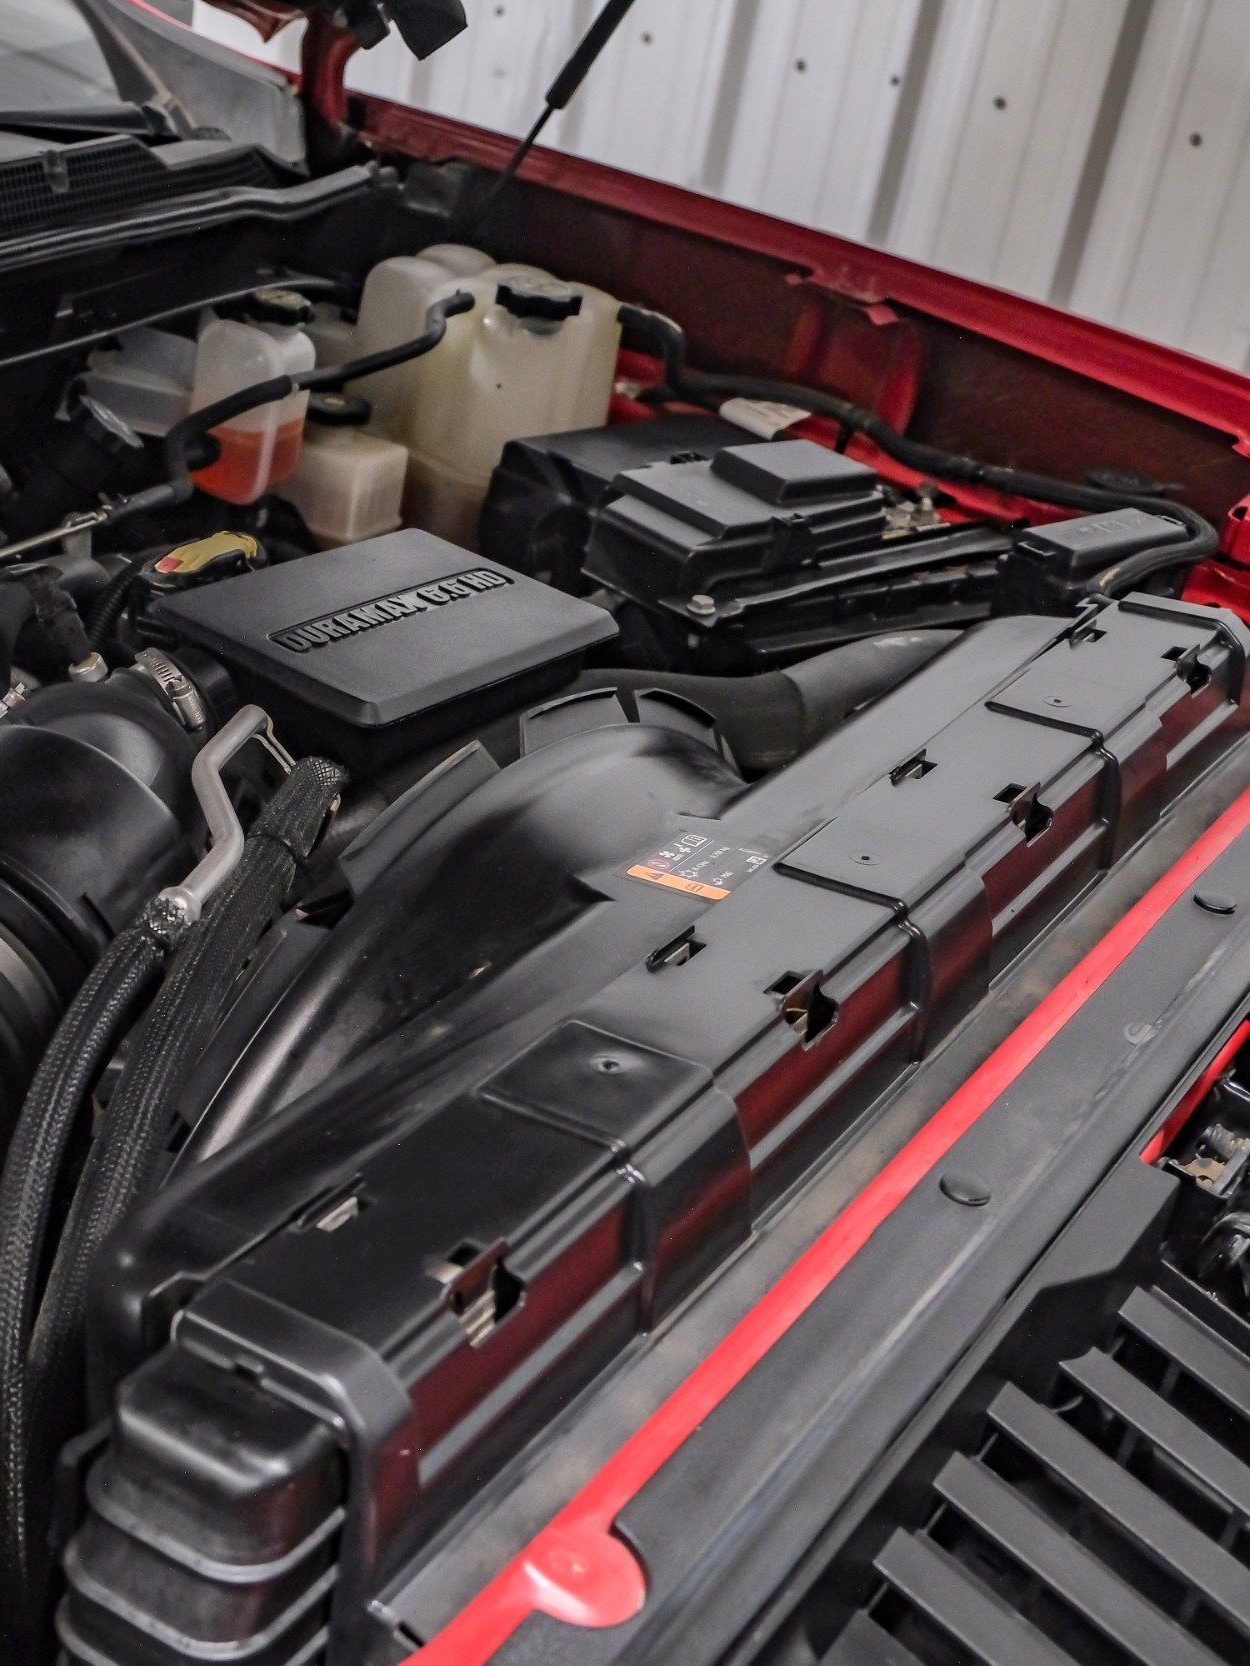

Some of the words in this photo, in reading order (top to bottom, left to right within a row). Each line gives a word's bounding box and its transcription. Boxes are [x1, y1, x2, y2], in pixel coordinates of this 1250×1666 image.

[284, 595, 427, 653] DURAMAX
[417, 577, 471, 605] 6.6
[457, 570, 507, 592] HD
